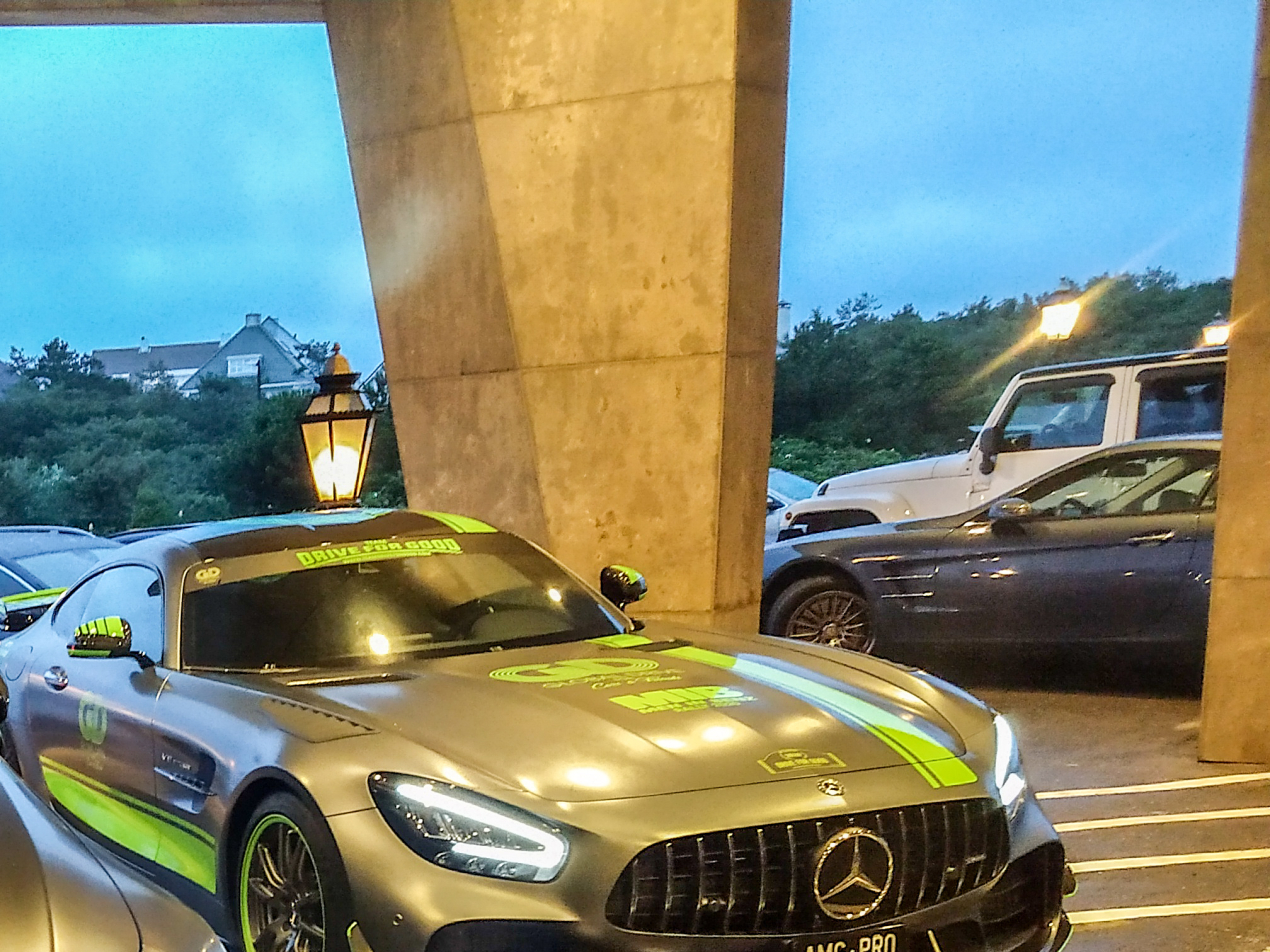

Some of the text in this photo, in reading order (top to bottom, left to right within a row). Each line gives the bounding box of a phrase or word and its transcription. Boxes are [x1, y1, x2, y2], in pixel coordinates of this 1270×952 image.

[296, 546, 360, 567] DRIVE
[363, 543, 403, 552] FOR
[405, 538, 462, 552] GOOD
